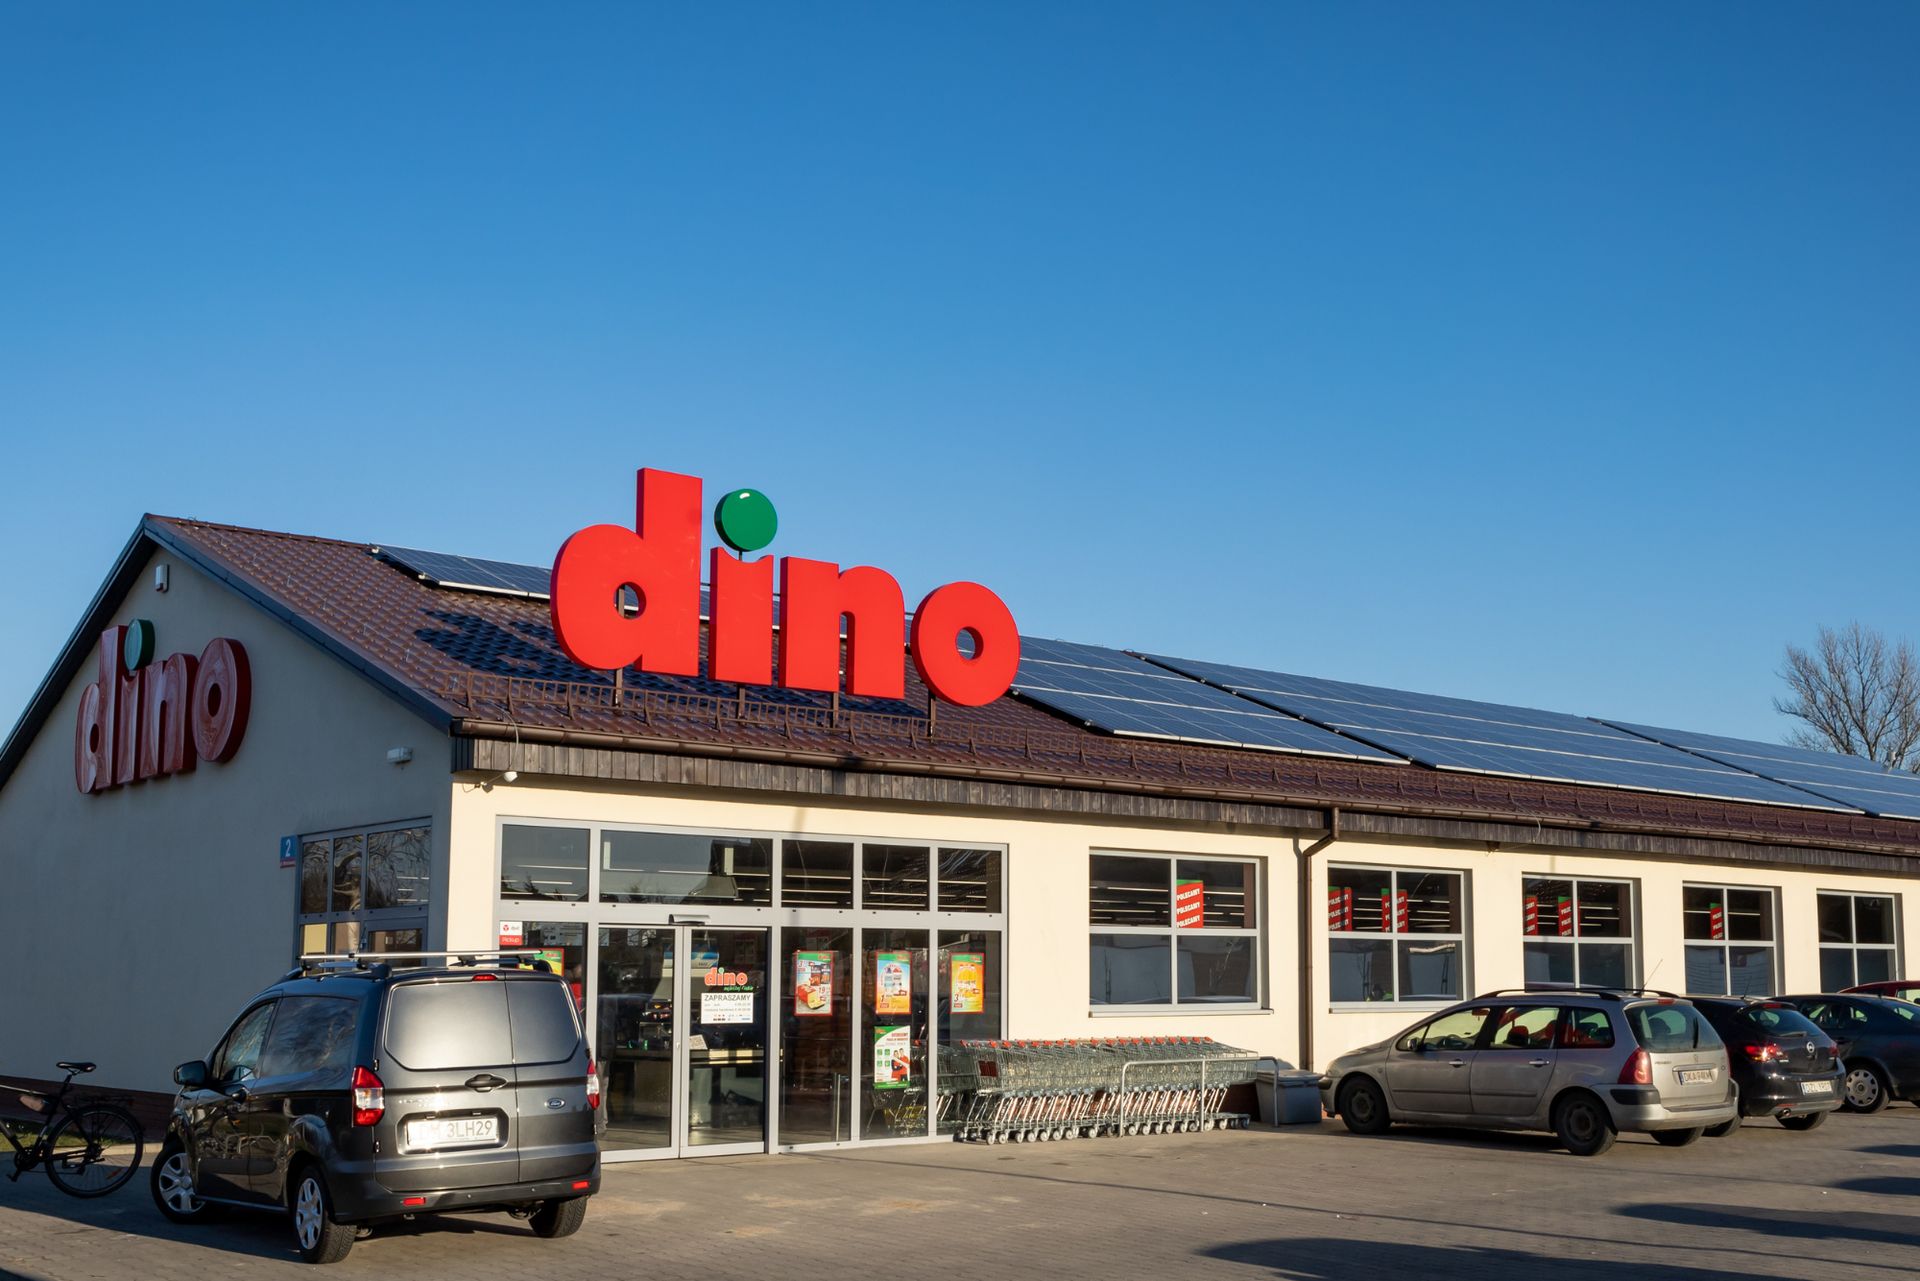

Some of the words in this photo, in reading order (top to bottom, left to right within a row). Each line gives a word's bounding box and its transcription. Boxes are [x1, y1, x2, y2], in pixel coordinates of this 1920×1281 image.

[551, 467, 1020, 706] dino
[76, 618, 252, 795] dino
[285, 838, 291, 857] 2
[704, 967, 748, 986] dino
[447, 1120, 493, 1138] 3LH29
